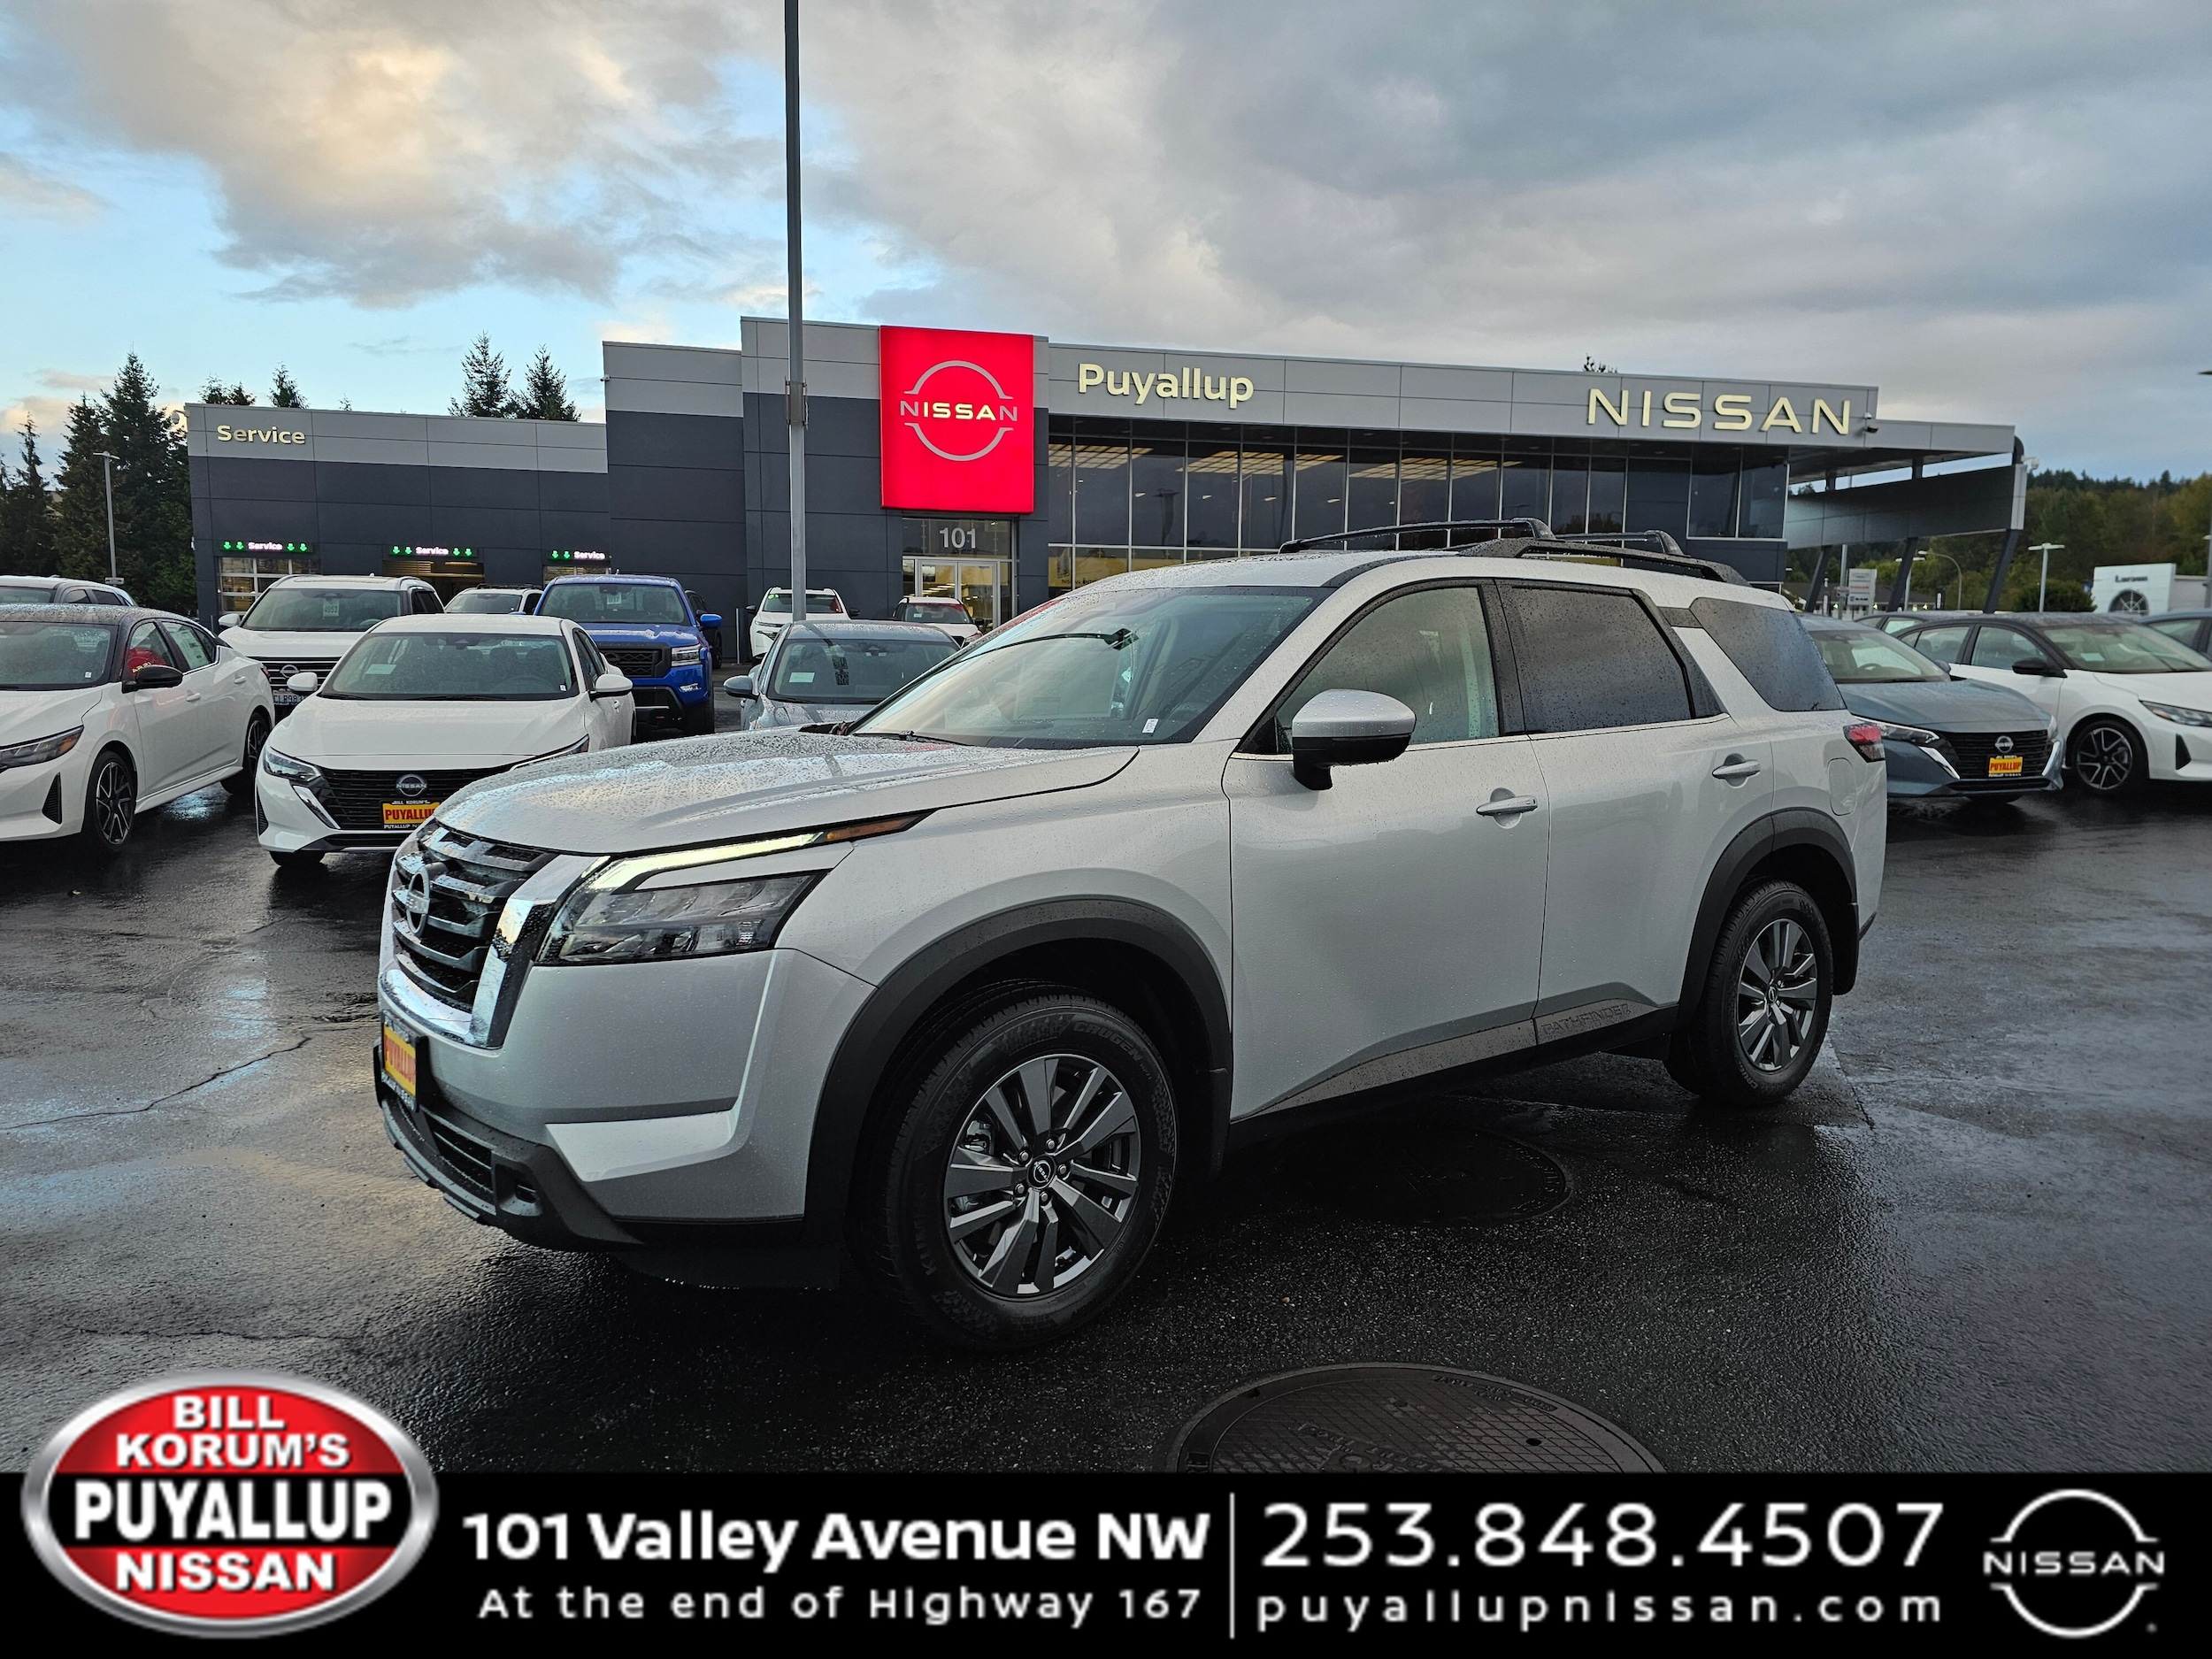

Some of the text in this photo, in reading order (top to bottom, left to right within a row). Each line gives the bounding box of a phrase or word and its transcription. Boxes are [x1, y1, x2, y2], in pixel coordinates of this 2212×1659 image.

[1079, 363, 1255, 409] Puyallup
[900, 400, 1018, 422] NISSAN
[1587, 388, 1851, 435] NISSAN
[217, 425, 305, 444] Service
[939, 526, 976, 549] 101
[248, 541, 283, 550] Service
[415, 546, 449, 556] Service
[573, 550, 605, 559] Service
[1990, 762, 2022, 772] PUYALLUP
[384, 808, 436, 820] PUYALLU
